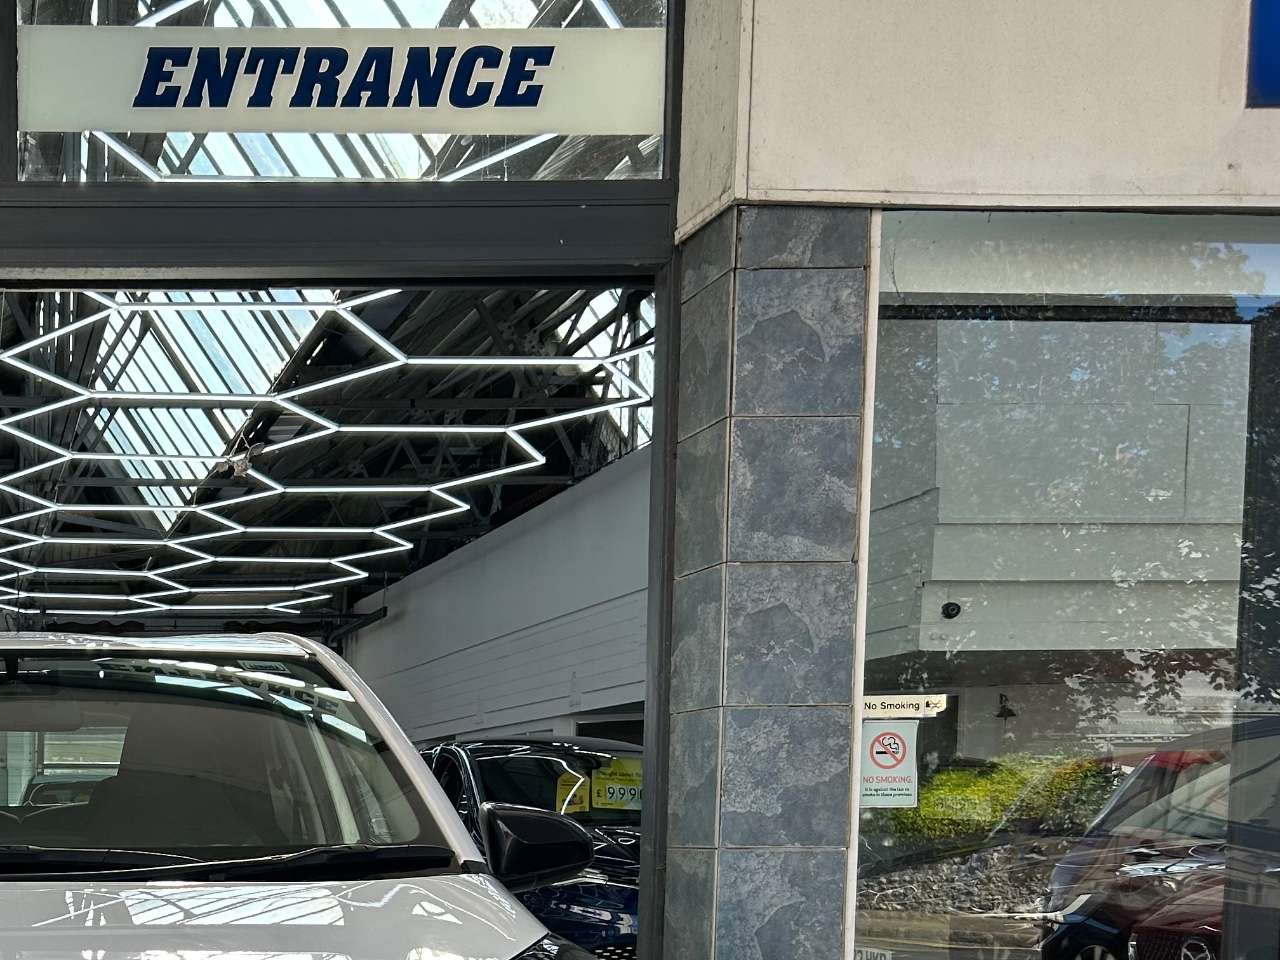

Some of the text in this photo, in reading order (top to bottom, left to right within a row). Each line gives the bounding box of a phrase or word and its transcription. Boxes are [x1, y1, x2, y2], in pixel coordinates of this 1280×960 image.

[132, 45, 556, 109] ENTRANCE
[864, 701, 920, 711] No Smoking
[863, 776, 874, 784] NO
[607, 786, 642, 800] 999
